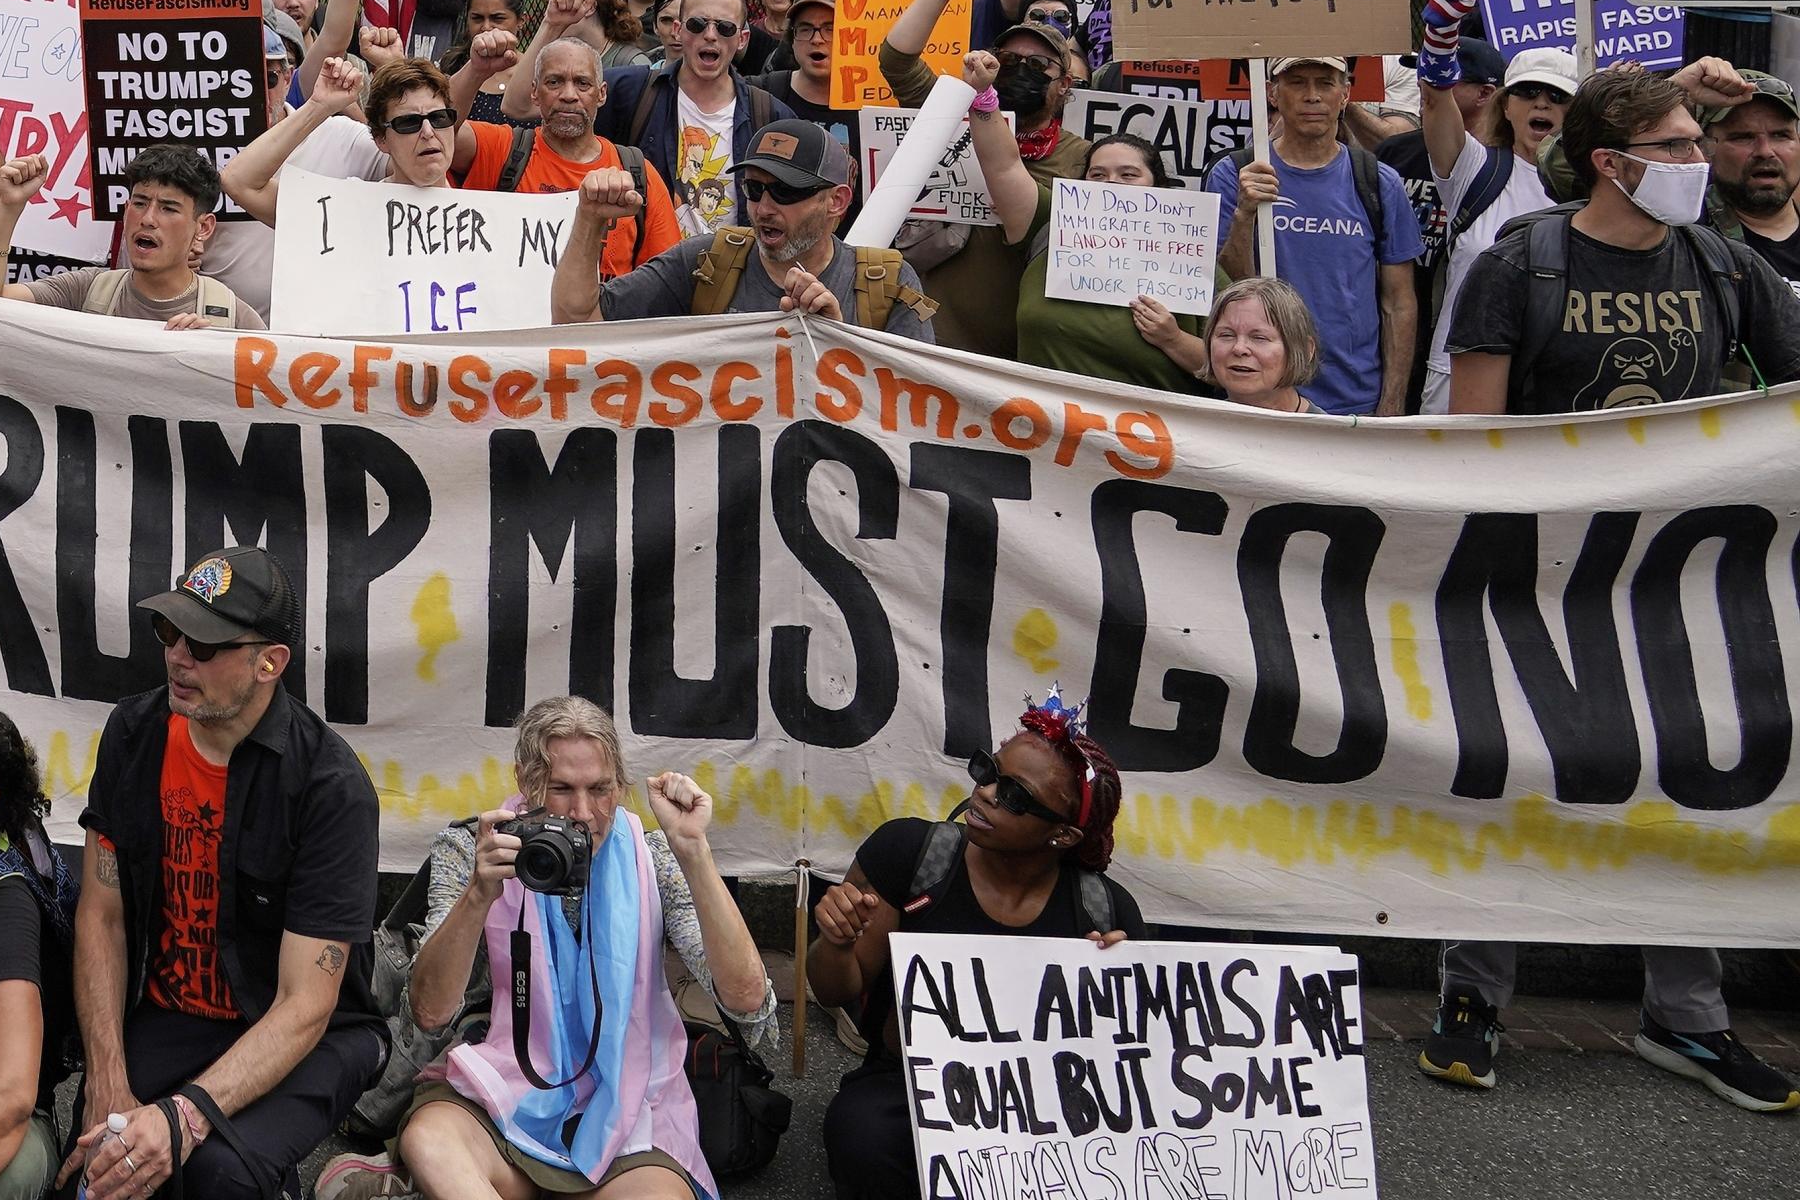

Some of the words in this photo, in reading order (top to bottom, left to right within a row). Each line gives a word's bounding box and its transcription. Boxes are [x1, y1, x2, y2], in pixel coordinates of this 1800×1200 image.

[117, 32, 167, 61] NO
[178, 31, 227, 60] TO
[97, 69, 253, 100] TRUMP'S
[105, 108, 250, 138] FASCIST
[938, 191, 986, 206] FUCK
[1059, 183, 1091, 210] MY
[1102, 190, 1137, 213] DAD
[960, 207, 991, 220] OFF
[1057, 211, 1151, 235] IMMIGRATE
[1158, 221, 1178, 235] TO
[1180, 224, 1209, 238] THE
[1273, 215, 1365, 237] OCEANA
[387, 199, 493, 257] PREFER
[519, 218, 564, 268] MY
[1133, 239, 1161, 253] THE
[1168, 241, 1204, 257] FREE
[1056, 251, 1095, 269] FOR
[1108, 256, 1130, 270] ME
[1140, 259, 1160, 272] TO
[1169, 262, 1203, 278] LIVE
[1069, 272, 1126, 294] UNDER
[1136, 278, 1207, 301] FASCISM
[1563, 290, 1703, 333] RESIST
[485, 418, 1032, 759] MUST
[1086, 478, 1386, 783] GO
[901, 953, 1021, 1047] ALL
[1033, 958, 1266, 1050] ANIMALS
[1275, 965, 1364, 1061] ARE
[908, 1057, 1058, 1134] EQUAL
[1053, 1047, 1157, 1137] BUT
[1171, 1044, 1322, 1131] SOME
[1233, 1123, 1368, 1200] MORE
